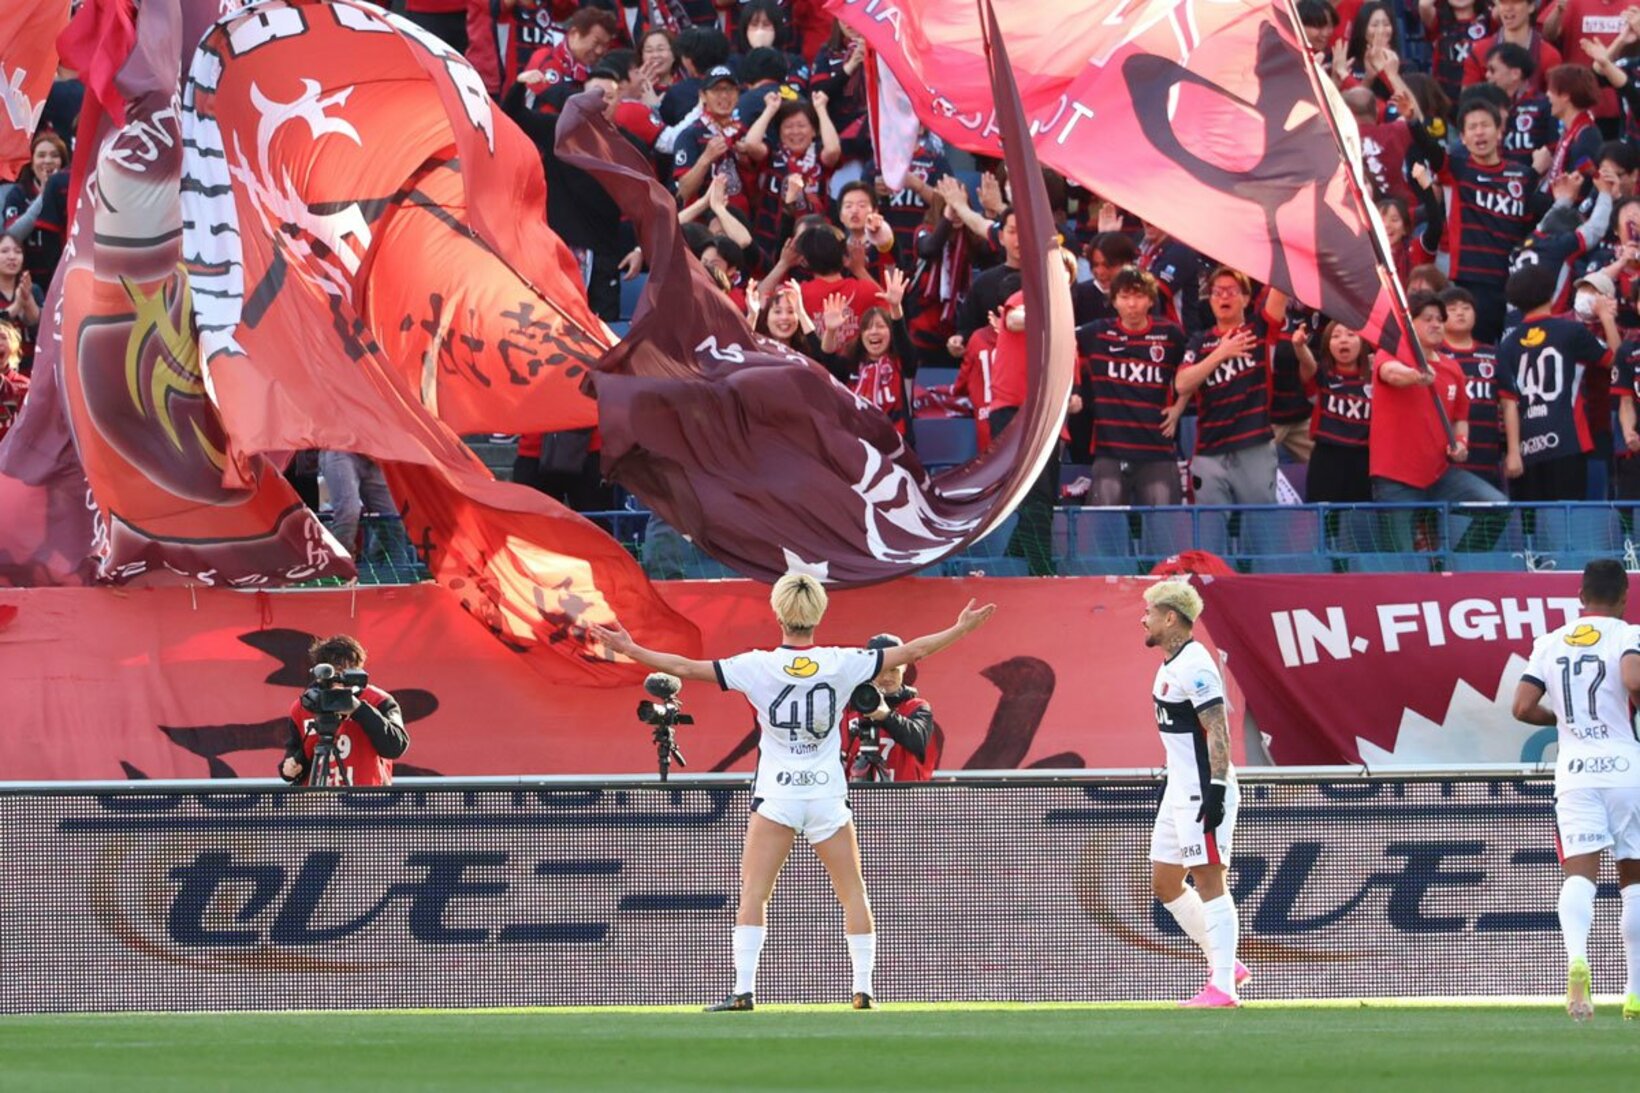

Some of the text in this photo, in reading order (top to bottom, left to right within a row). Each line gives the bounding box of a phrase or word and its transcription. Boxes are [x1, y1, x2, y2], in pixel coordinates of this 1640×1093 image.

[523, 27, 554, 44] LIX
[1107, 361, 1164, 383] LIXIL
[1205, 357, 1257, 386] LIXIL
[1517, 346, 1563, 405] 40
[1327, 395, 1371, 420] LIXI
[1556, 654, 1606, 724] 17
[769, 682, 836, 741] 40
[167, 851, 728, 945] セレモニー
